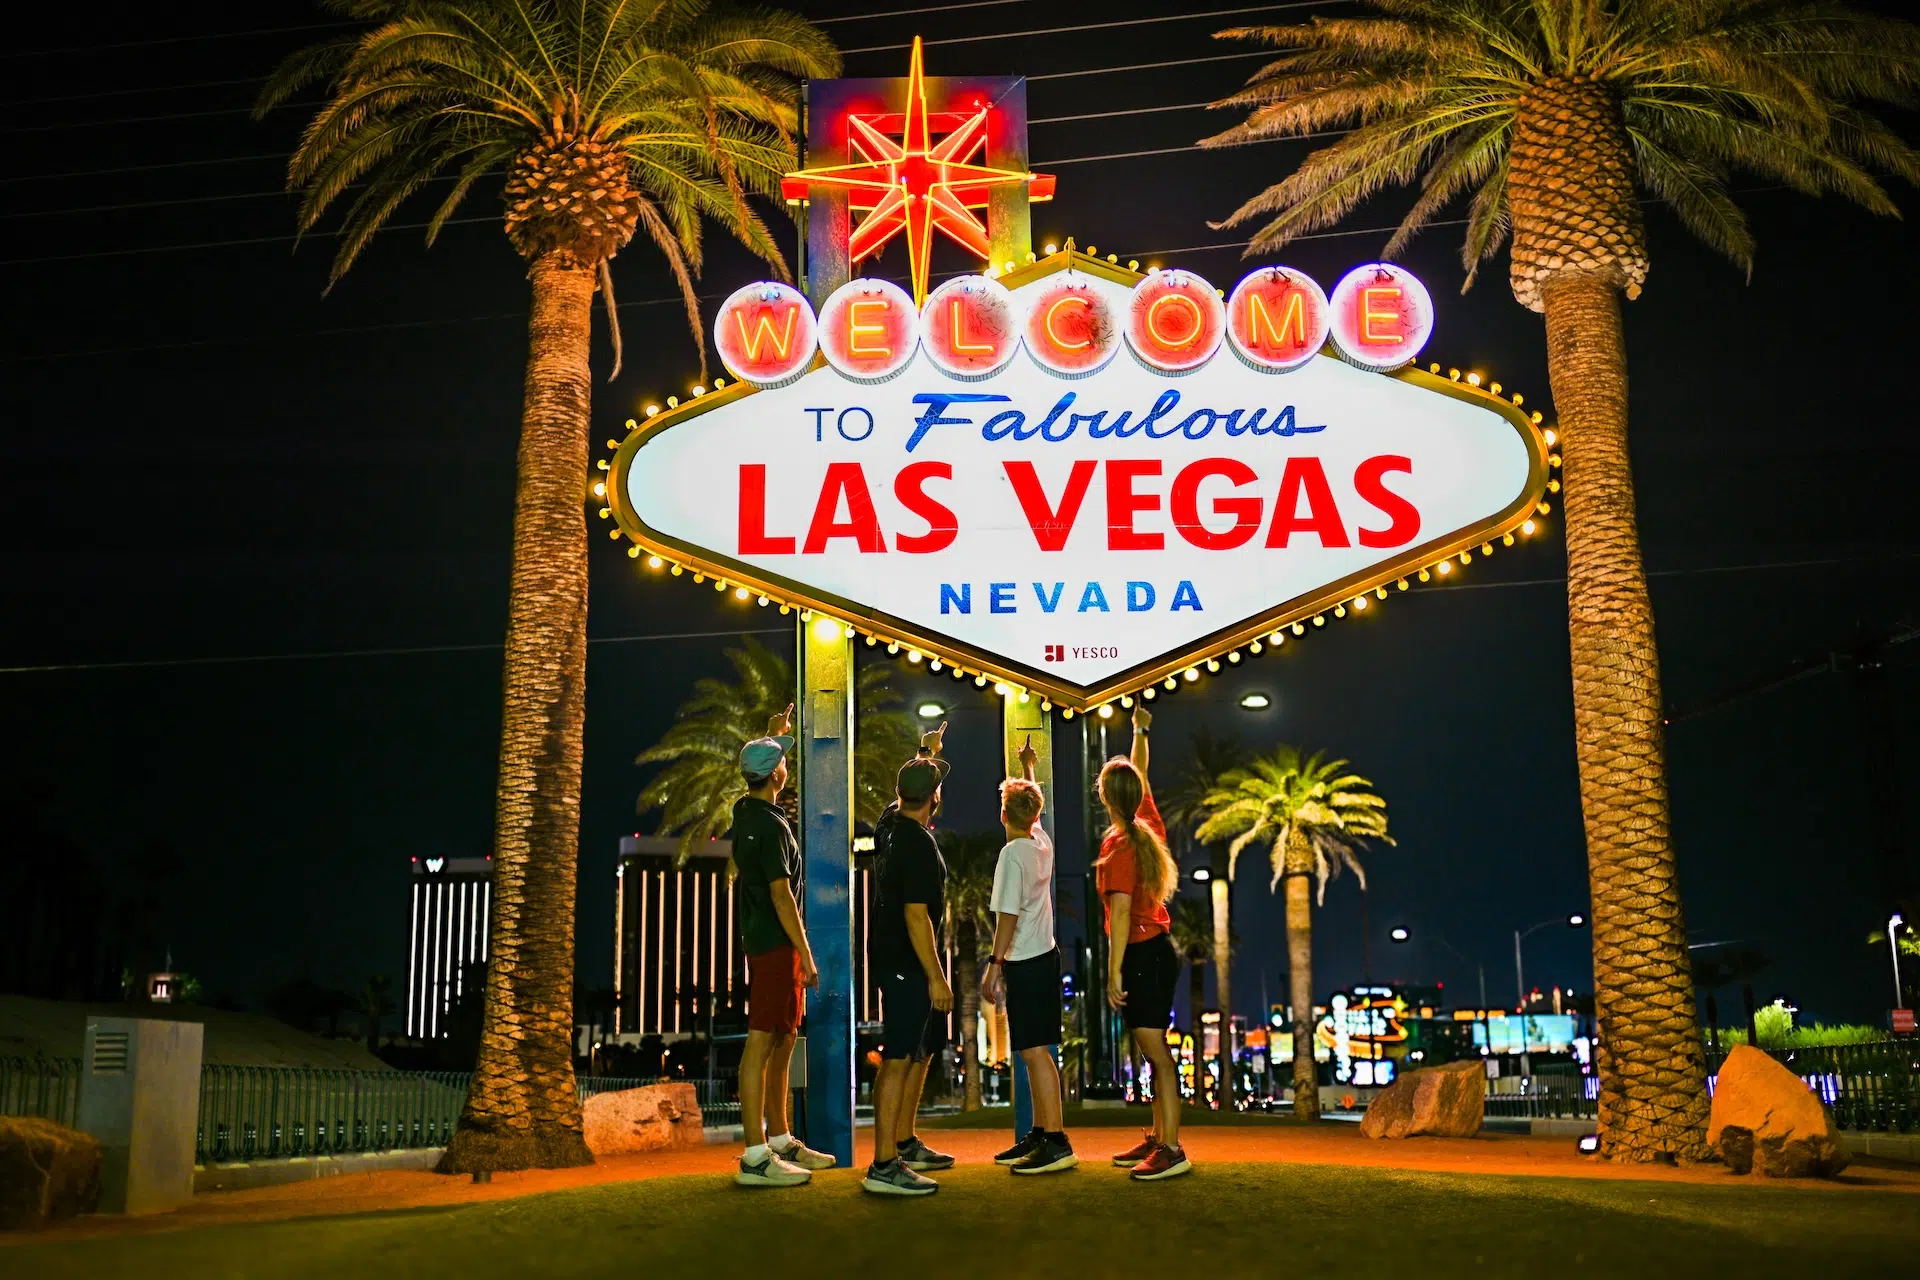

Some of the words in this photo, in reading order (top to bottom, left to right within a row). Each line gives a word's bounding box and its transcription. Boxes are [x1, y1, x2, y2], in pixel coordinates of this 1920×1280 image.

[732, 283, 1408, 361] WELCOME
[804, 407, 874, 441] TO
[905, 390, 1327, 453] Fabulous
[738, 461, 959, 555] LAS
[1002, 454, 1422, 552] VEGAS
[940, 580, 1204, 615] NEVADA
[1072, 646, 1119, 659] YESCO
[426, 858, 444, 873] W
